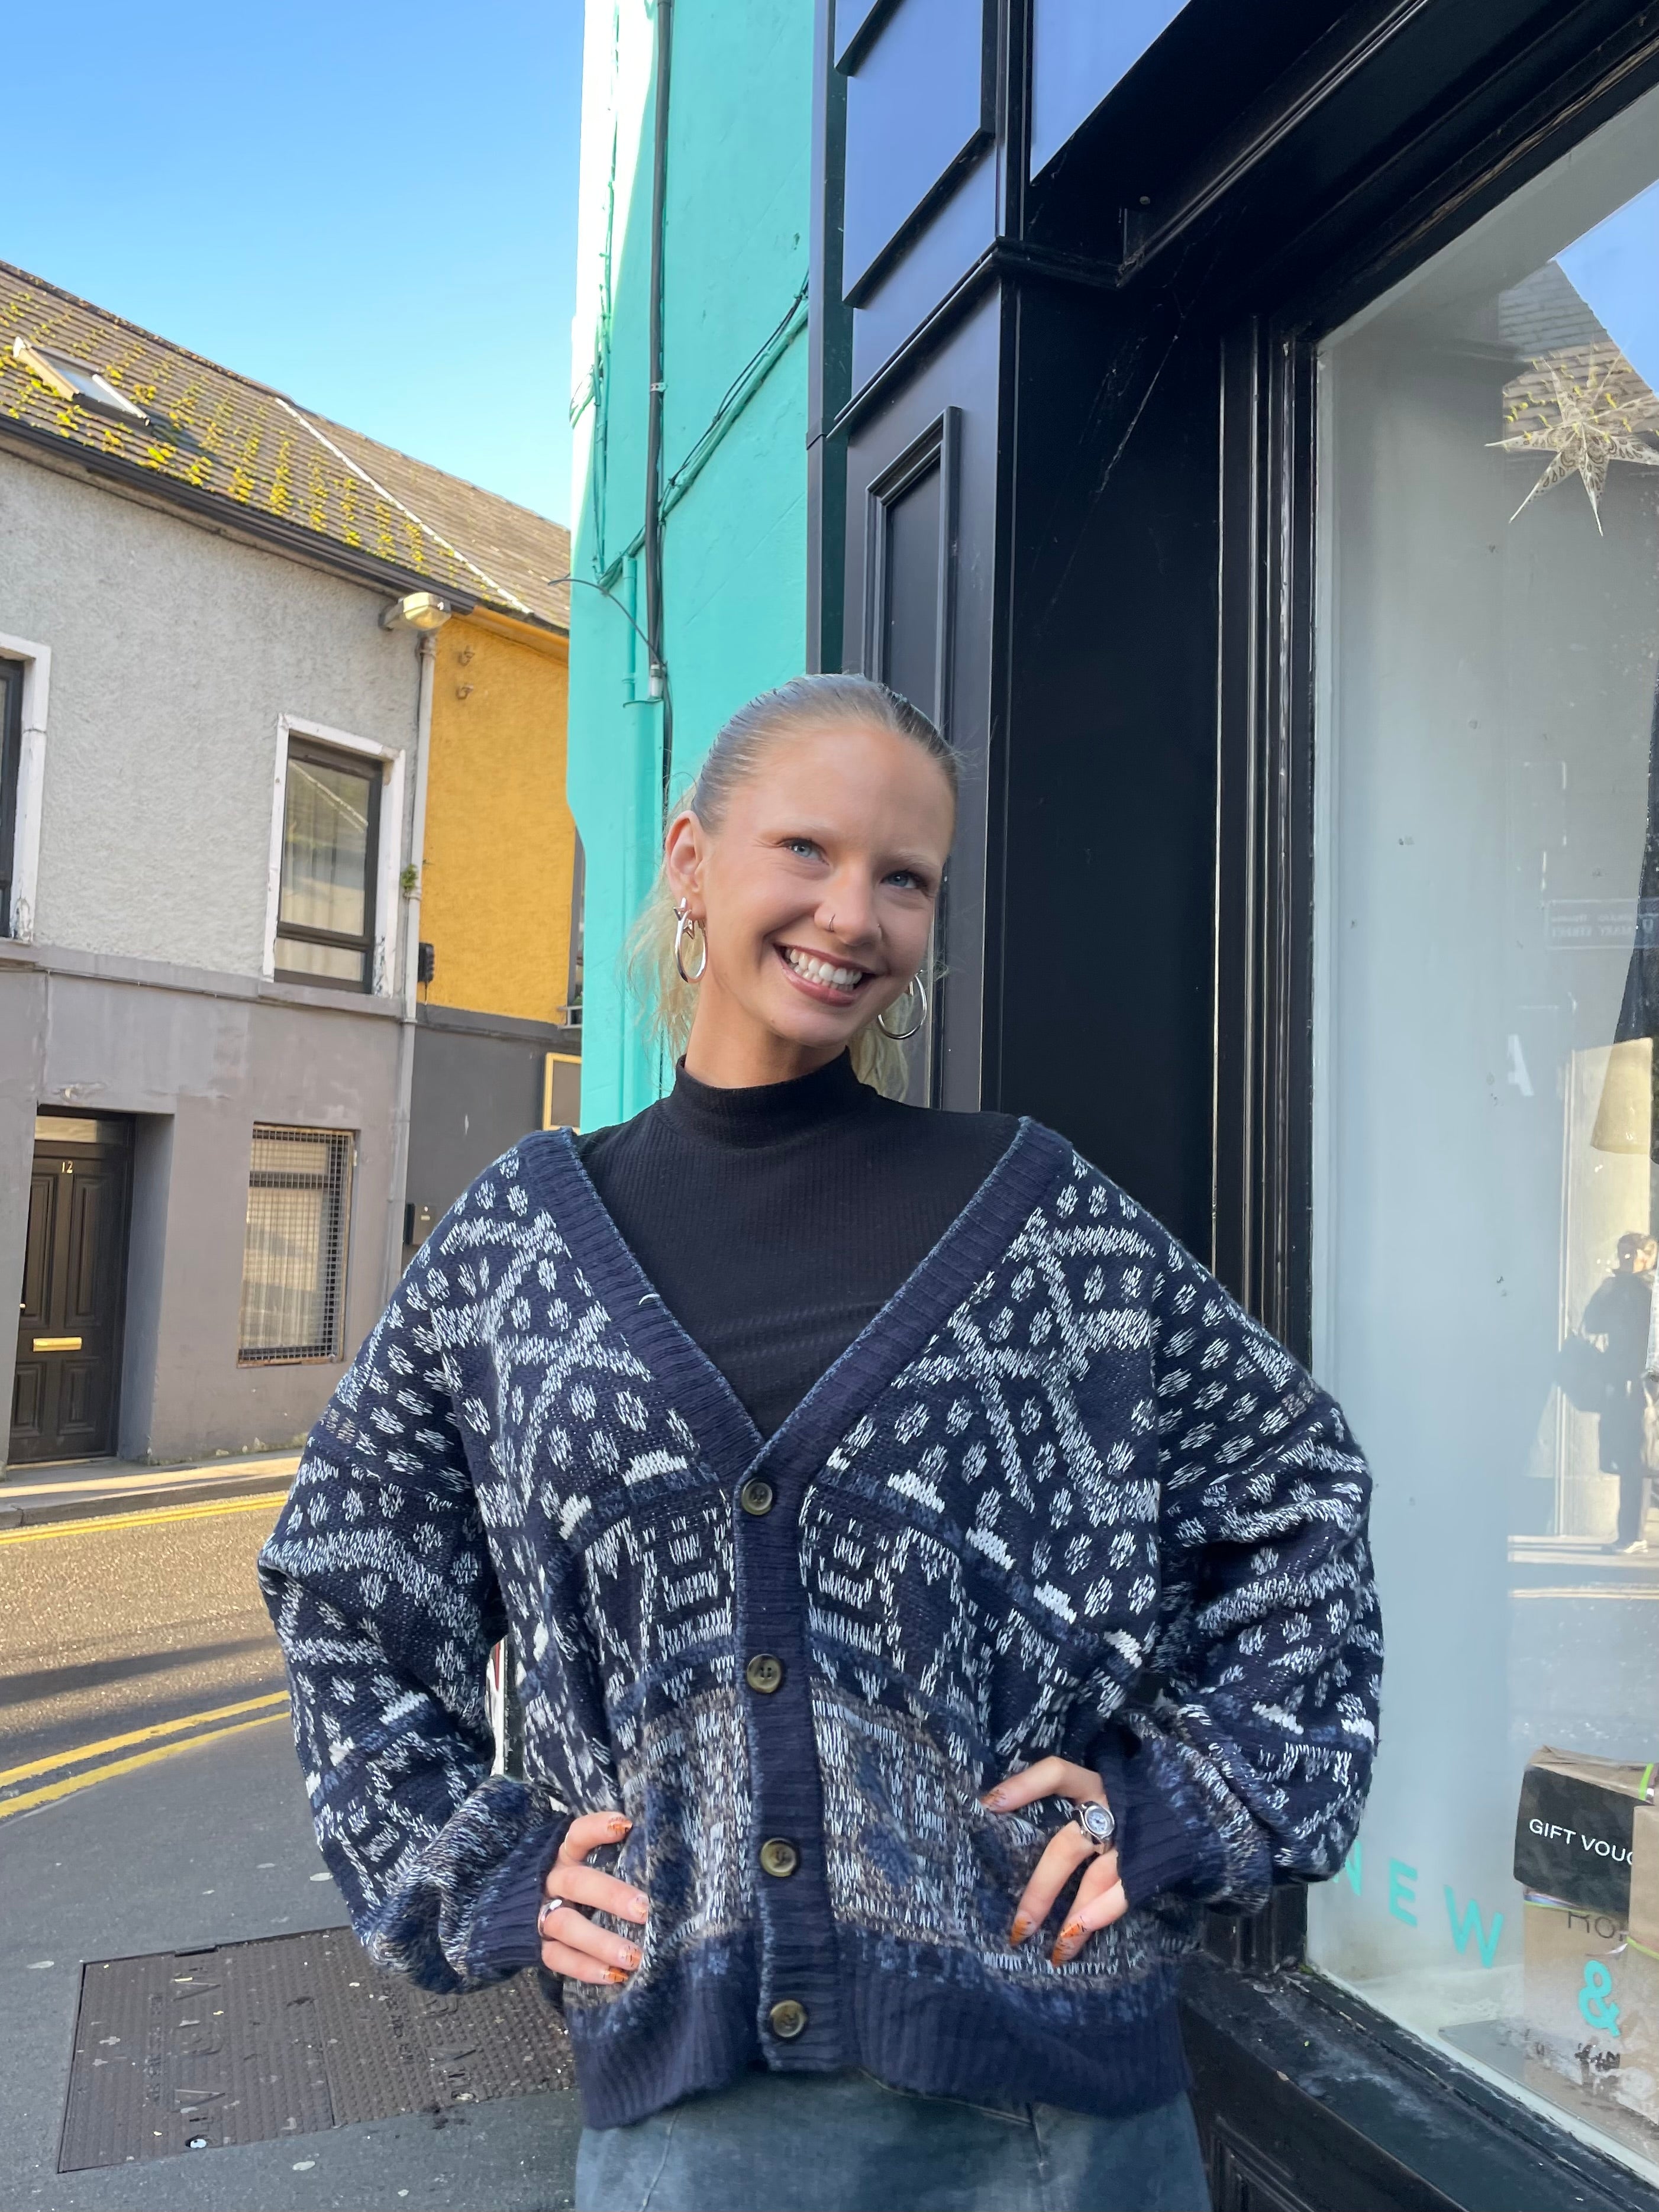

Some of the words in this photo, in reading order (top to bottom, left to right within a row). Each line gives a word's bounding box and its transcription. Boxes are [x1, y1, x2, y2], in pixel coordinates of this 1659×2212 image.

[62, 1161, 73, 1174] 12
[1529, 1819, 1576, 1845] GIFT
[1333, 1841, 1504, 1969] NEW
[1578, 1960, 1621, 2037] &
